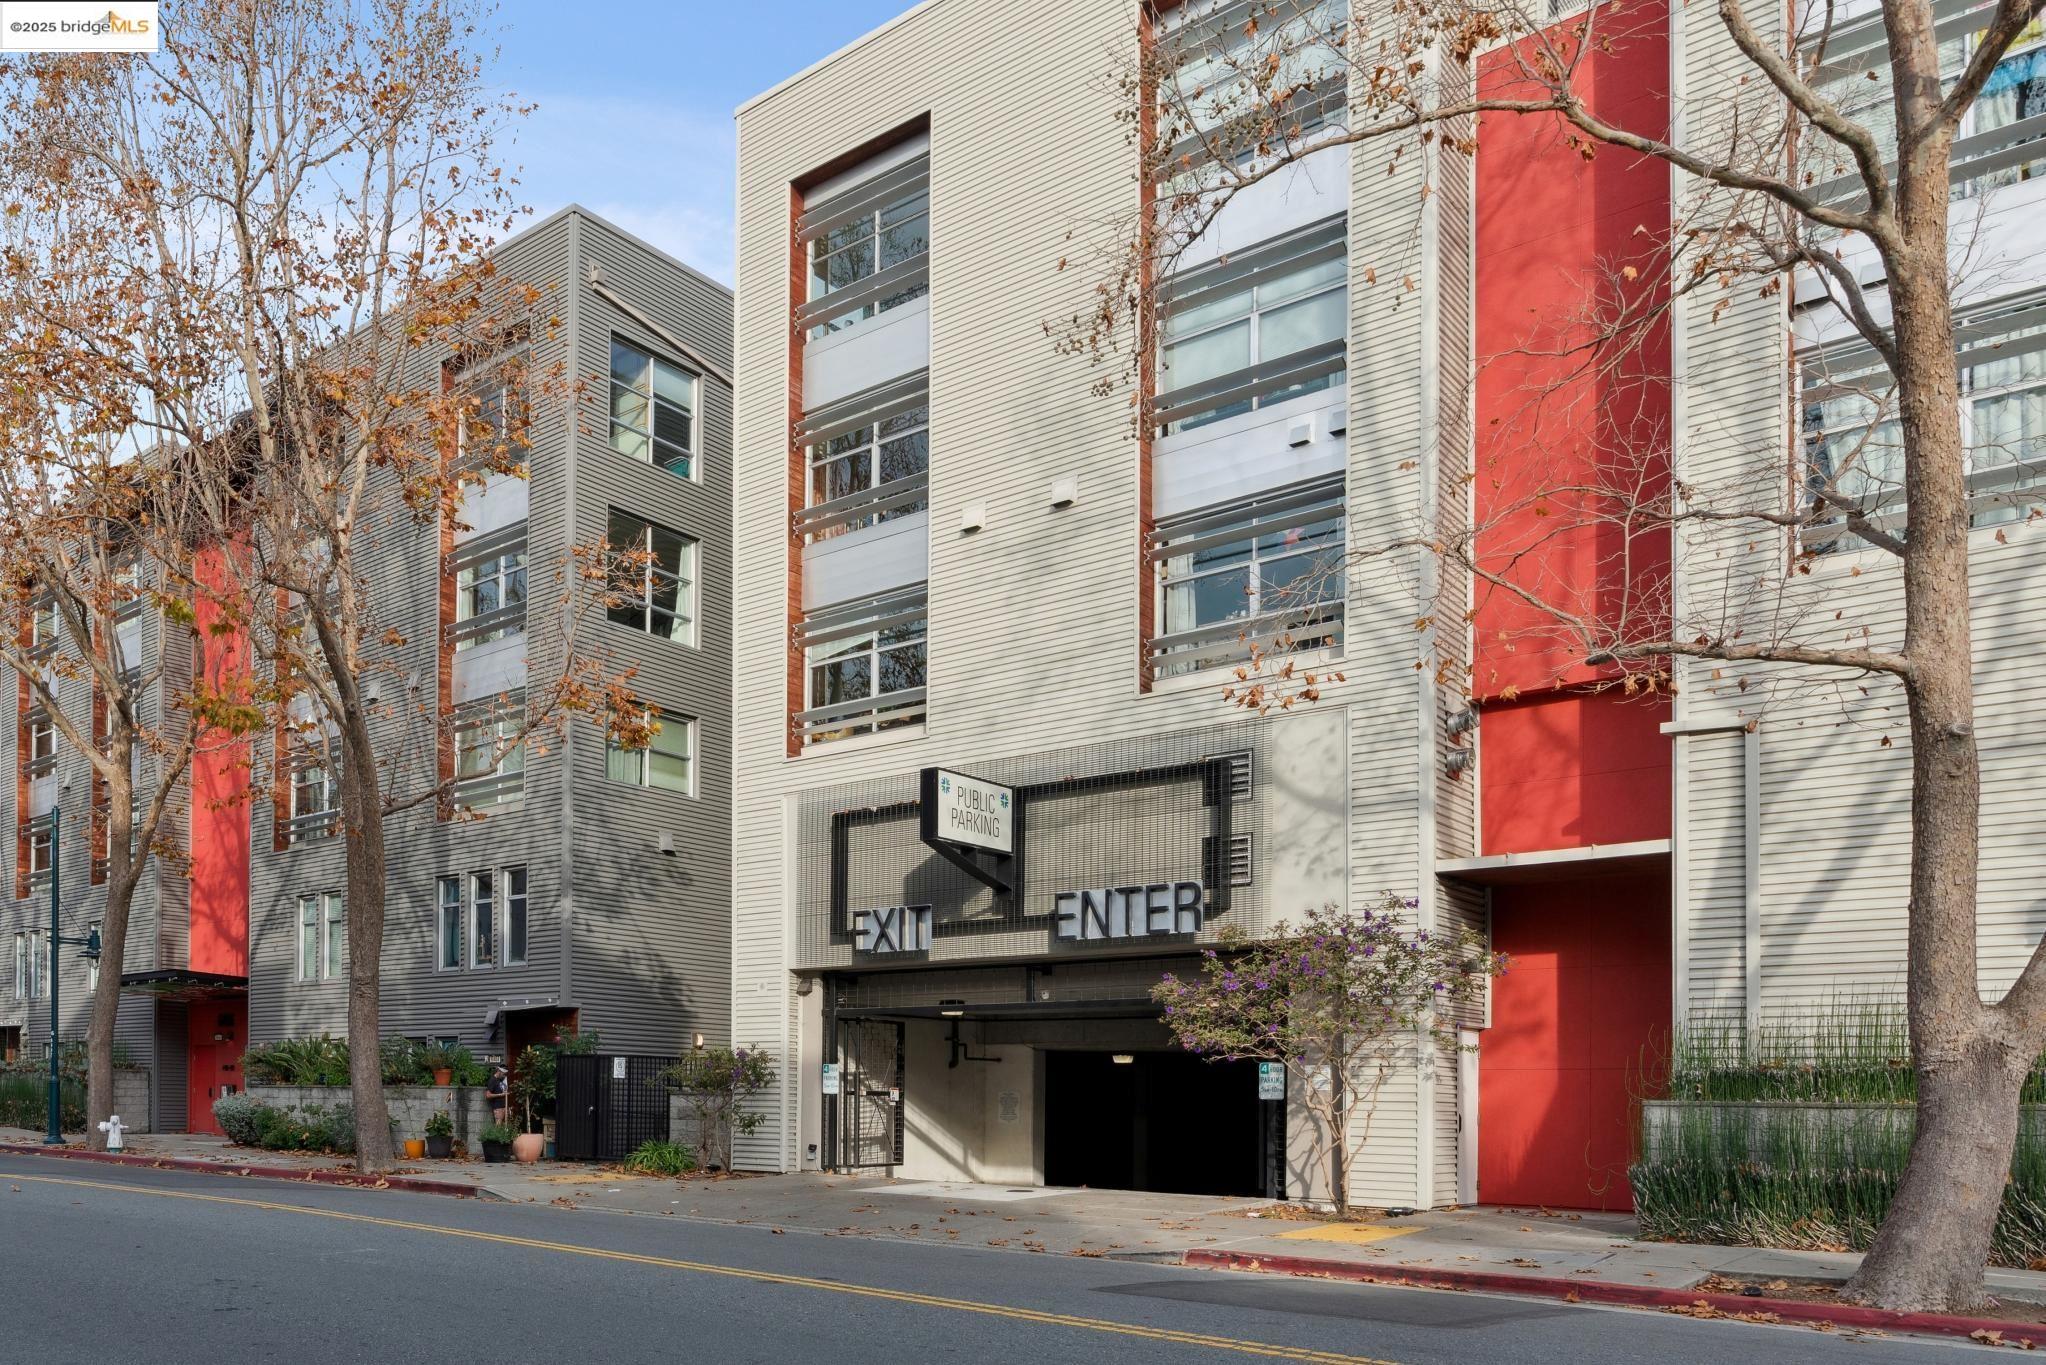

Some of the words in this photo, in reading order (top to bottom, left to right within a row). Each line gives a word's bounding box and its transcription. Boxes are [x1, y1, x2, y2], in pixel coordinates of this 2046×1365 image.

[957, 785, 996, 814] PUBLIC
[951, 807, 1000, 838] PARKING
[852, 904, 932, 954] EXIT
[1054, 881, 1203, 943] ENTER
